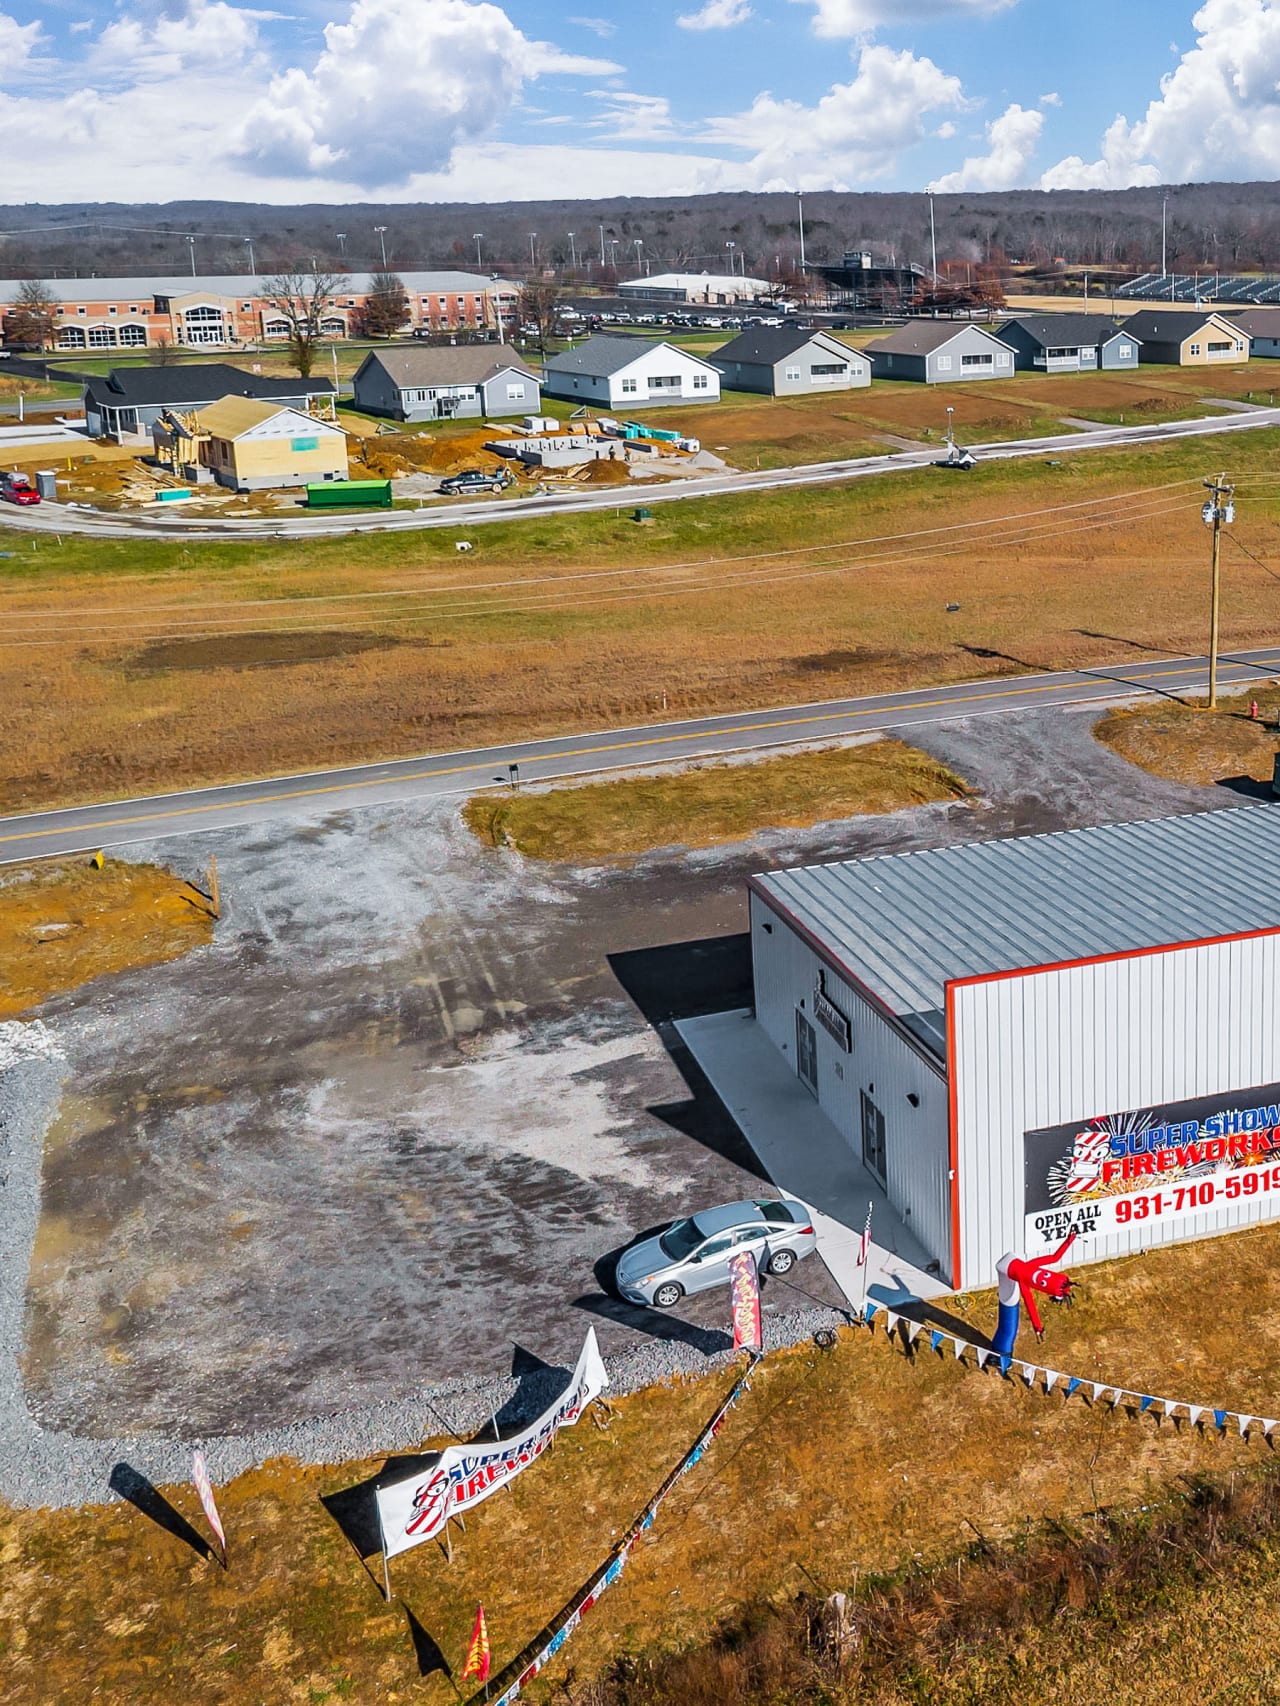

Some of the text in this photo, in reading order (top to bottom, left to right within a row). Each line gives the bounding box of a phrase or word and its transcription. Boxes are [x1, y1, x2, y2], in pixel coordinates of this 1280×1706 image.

[1110, 1119, 1199, 1158] SUPER
[1035, 1204, 1102, 1230] OPEN ALL
[1041, 1220, 1097, 1243] YEAR
[448, 1436, 538, 1483] SUPER
